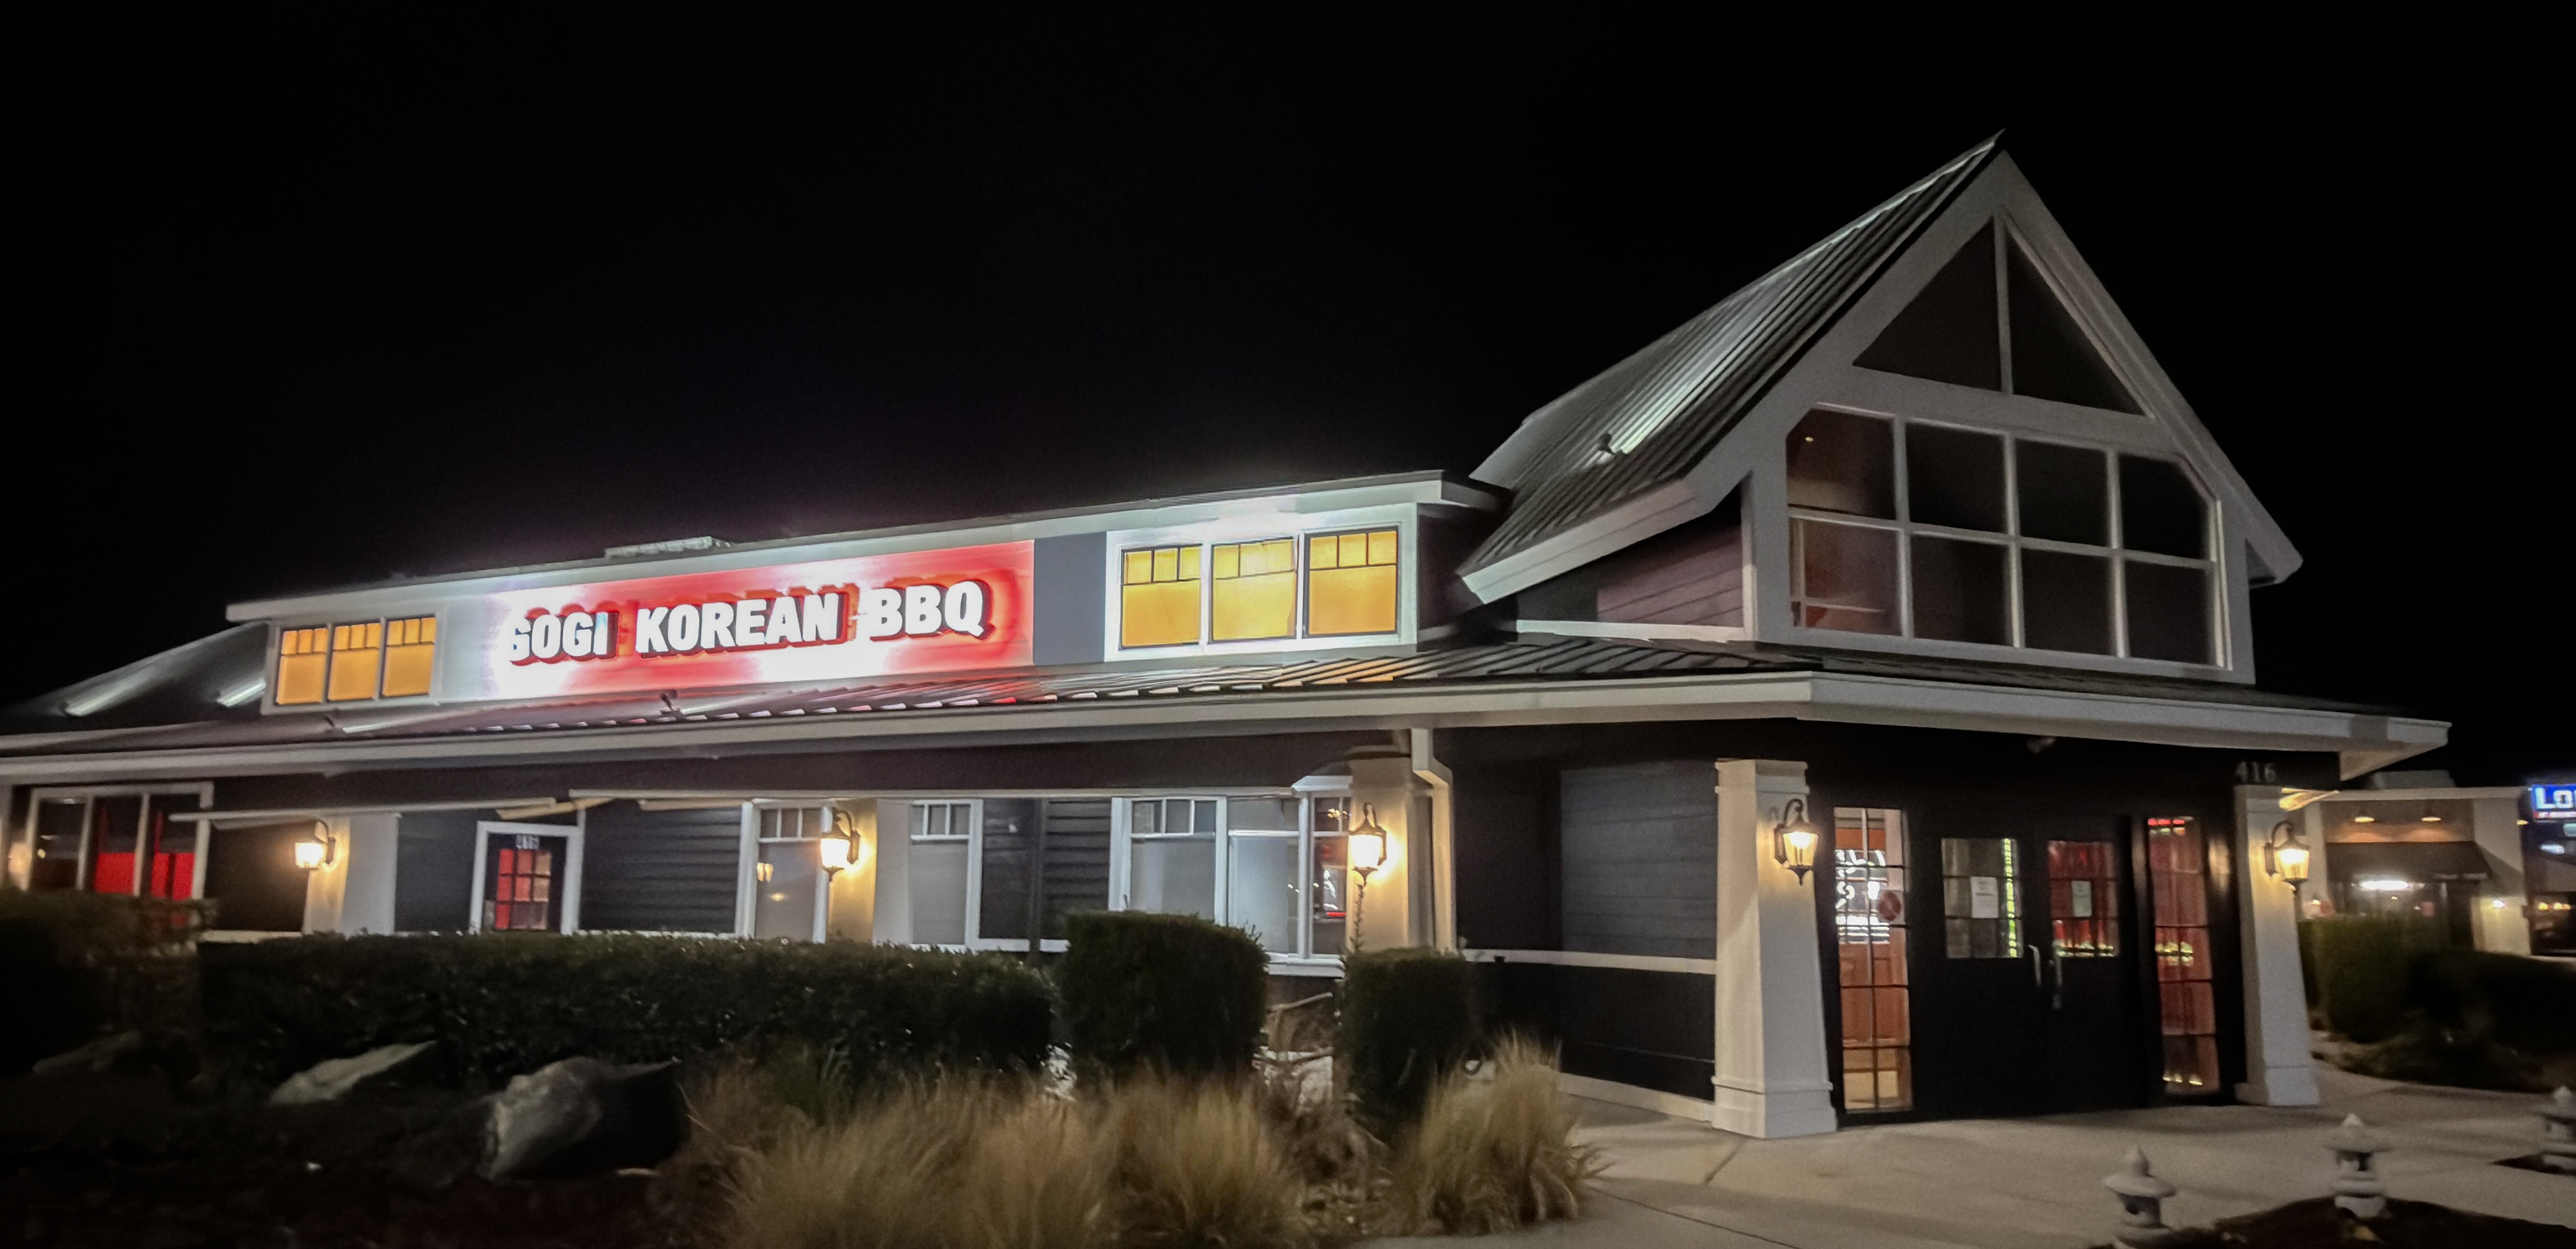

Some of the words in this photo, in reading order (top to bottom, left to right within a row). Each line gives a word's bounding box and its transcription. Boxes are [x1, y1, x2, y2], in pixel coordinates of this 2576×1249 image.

[506, 612, 609, 661] GOGI
[636, 593, 839, 653] KOREAN
[868, 580, 984, 637] BBQ
[2235, 761, 2276, 783] 416
[2535, 787, 2576, 809] LO
